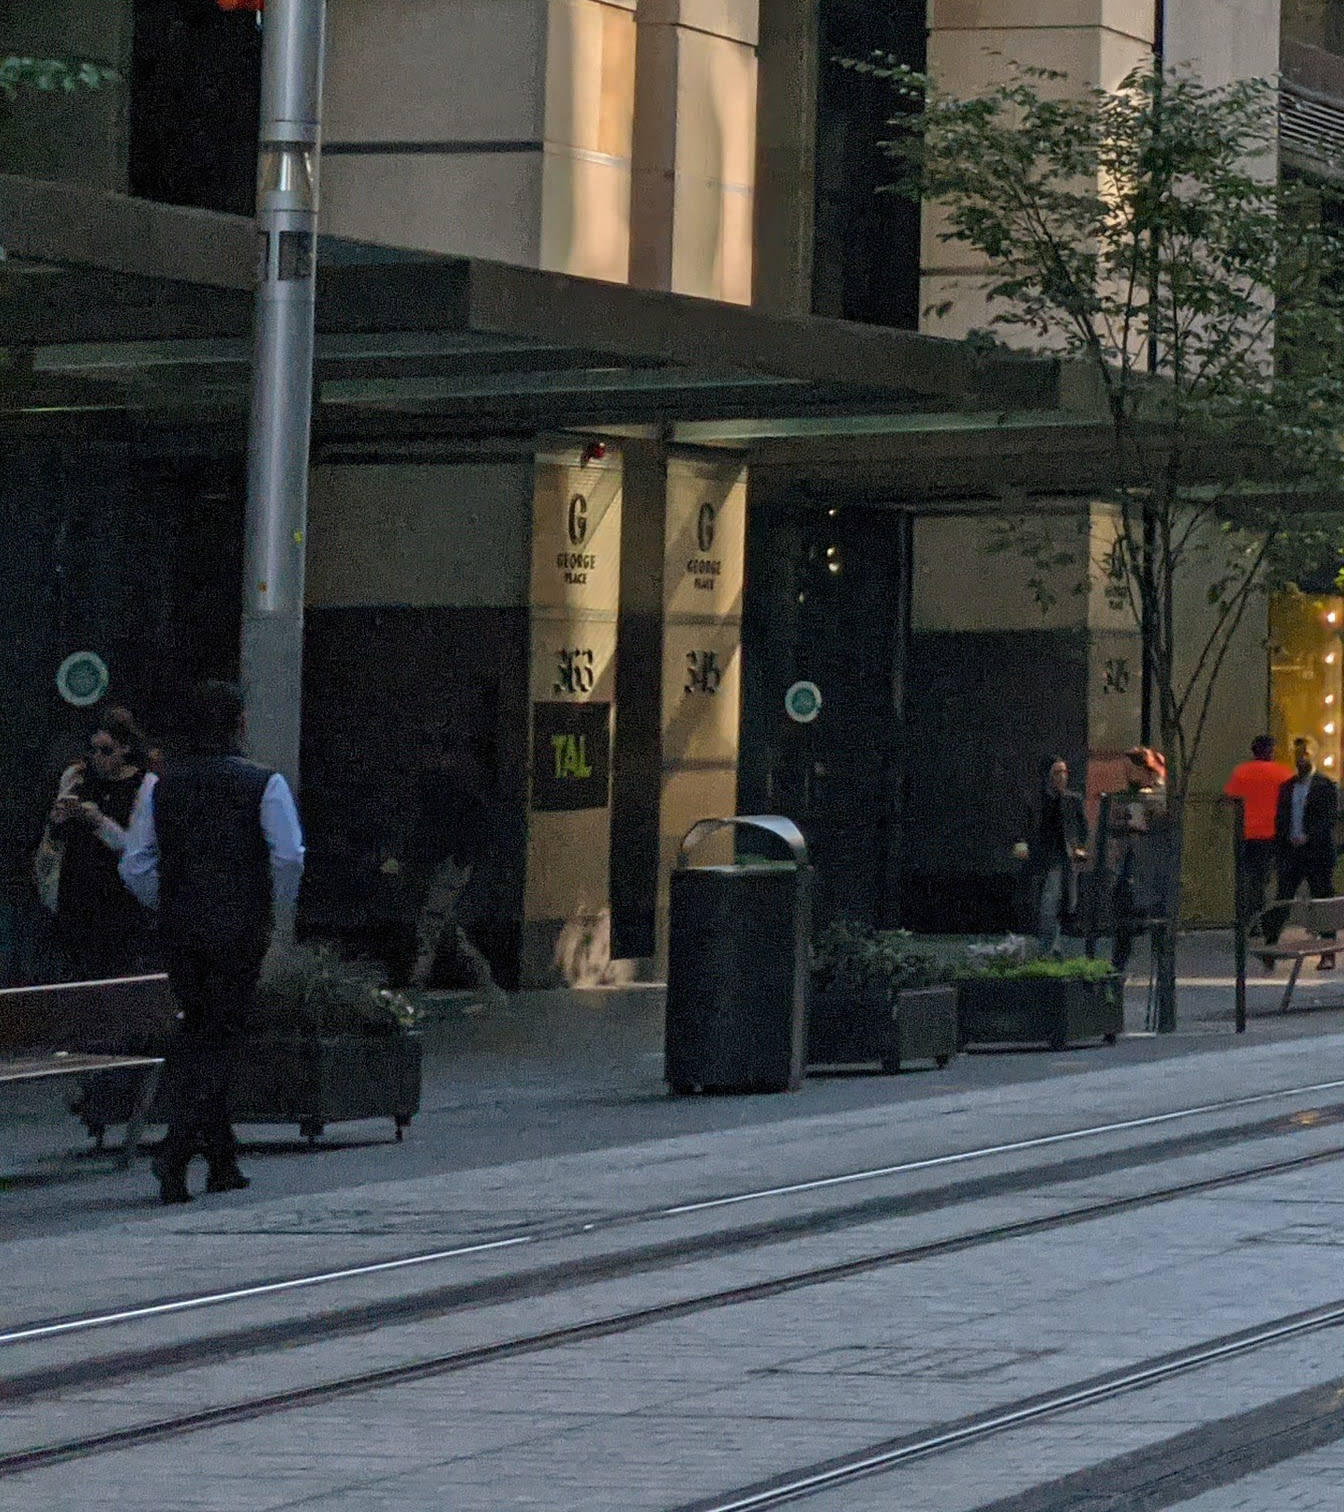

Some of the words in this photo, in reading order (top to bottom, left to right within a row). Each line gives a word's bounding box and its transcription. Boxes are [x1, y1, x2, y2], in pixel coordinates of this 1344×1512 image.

[568, 493, 588, 546] G
[556, 552, 596, 571] GEORGE
[686, 559, 722, 577] GEORGE
[563, 572, 588, 585] PLACE
[551, 734, 593, 779] TAL
